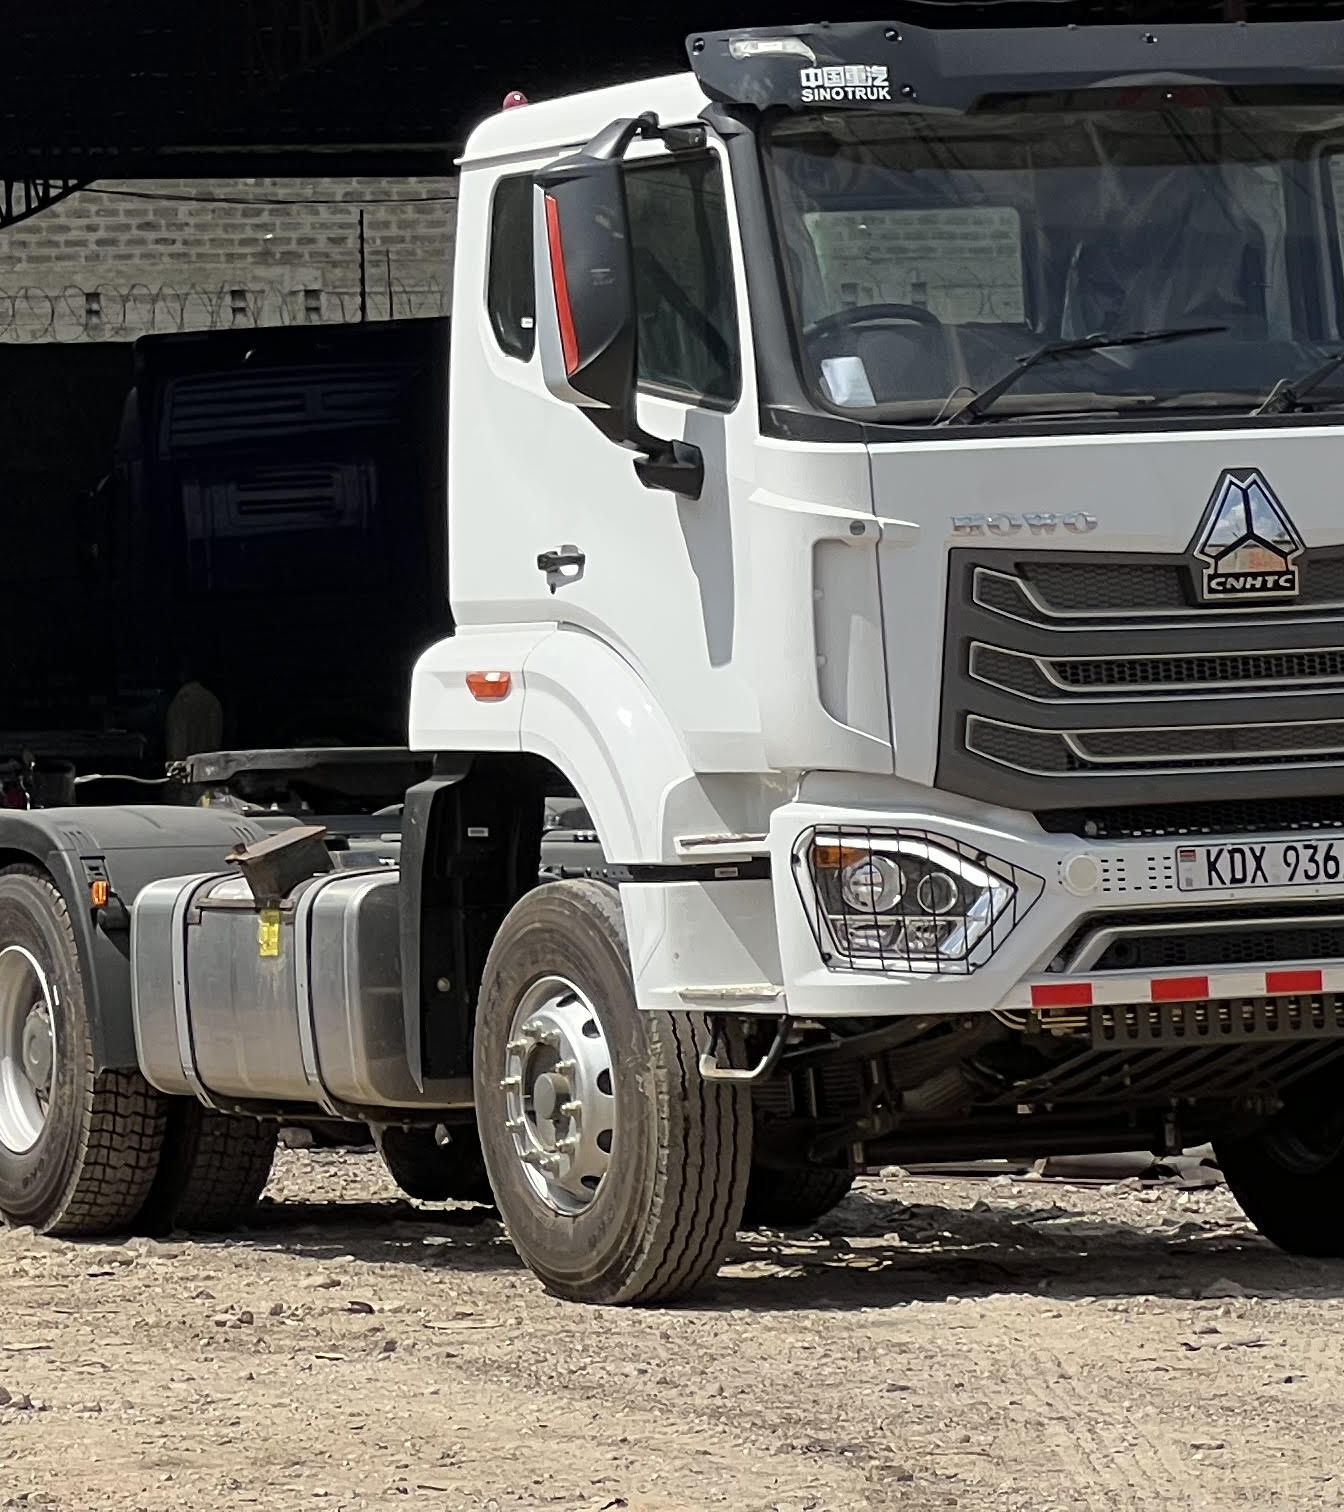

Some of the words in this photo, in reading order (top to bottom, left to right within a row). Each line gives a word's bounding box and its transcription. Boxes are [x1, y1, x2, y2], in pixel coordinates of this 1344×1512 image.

[801, 87, 892, 102] SINOTRUK
[1210, 574, 1293, 590] CNHTC
[1206, 846, 1269, 886] KDX
[1283, 843, 1340, 882] 936
